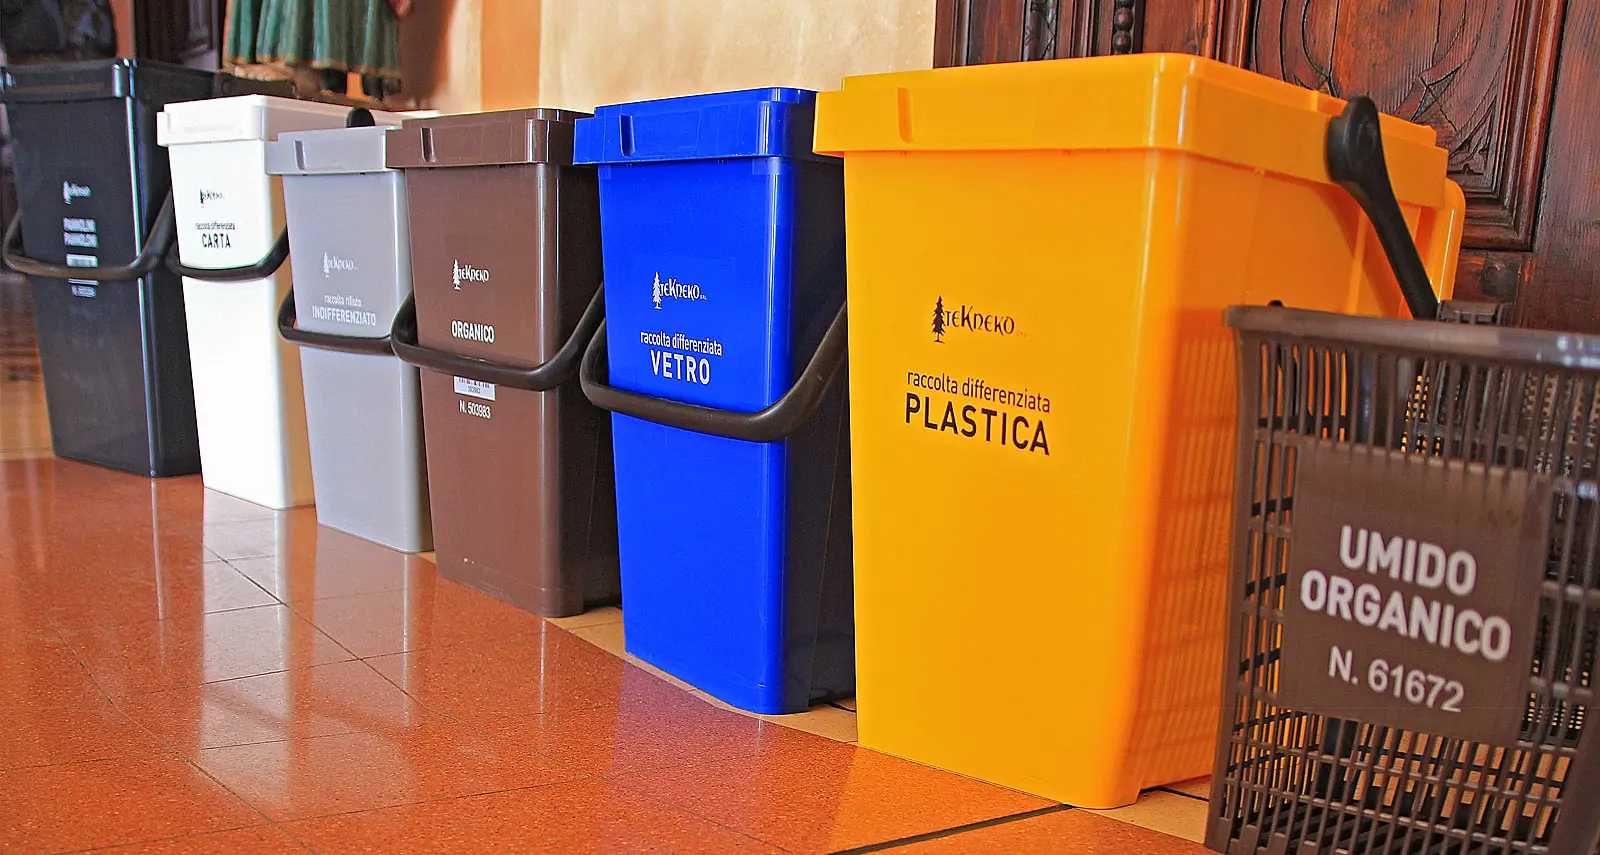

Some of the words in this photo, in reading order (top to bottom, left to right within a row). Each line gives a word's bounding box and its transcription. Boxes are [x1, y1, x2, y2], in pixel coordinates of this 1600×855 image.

[202, 233, 231, 249] CARTA
[311, 305, 376, 326] INDIFFERENZIATO
[451, 320, 495, 343] ORGANICO
[640, 331, 671, 347] raccolta
[672, 333, 723, 356] differenziata
[650, 349, 710, 385] VETRO
[459, 400, 467, 414] N.
[907, 371, 958, 394] raccolta
[962, 378, 1051, 413] differenziata
[905, 392, 1050, 456] PLASTICA
[1339, 524, 1477, 596] UMIDO
[1300, 569, 1512, 661] ORGANICO
[1328, 645, 1358, 685] N.
[1367, 658, 1465, 713] 61672
